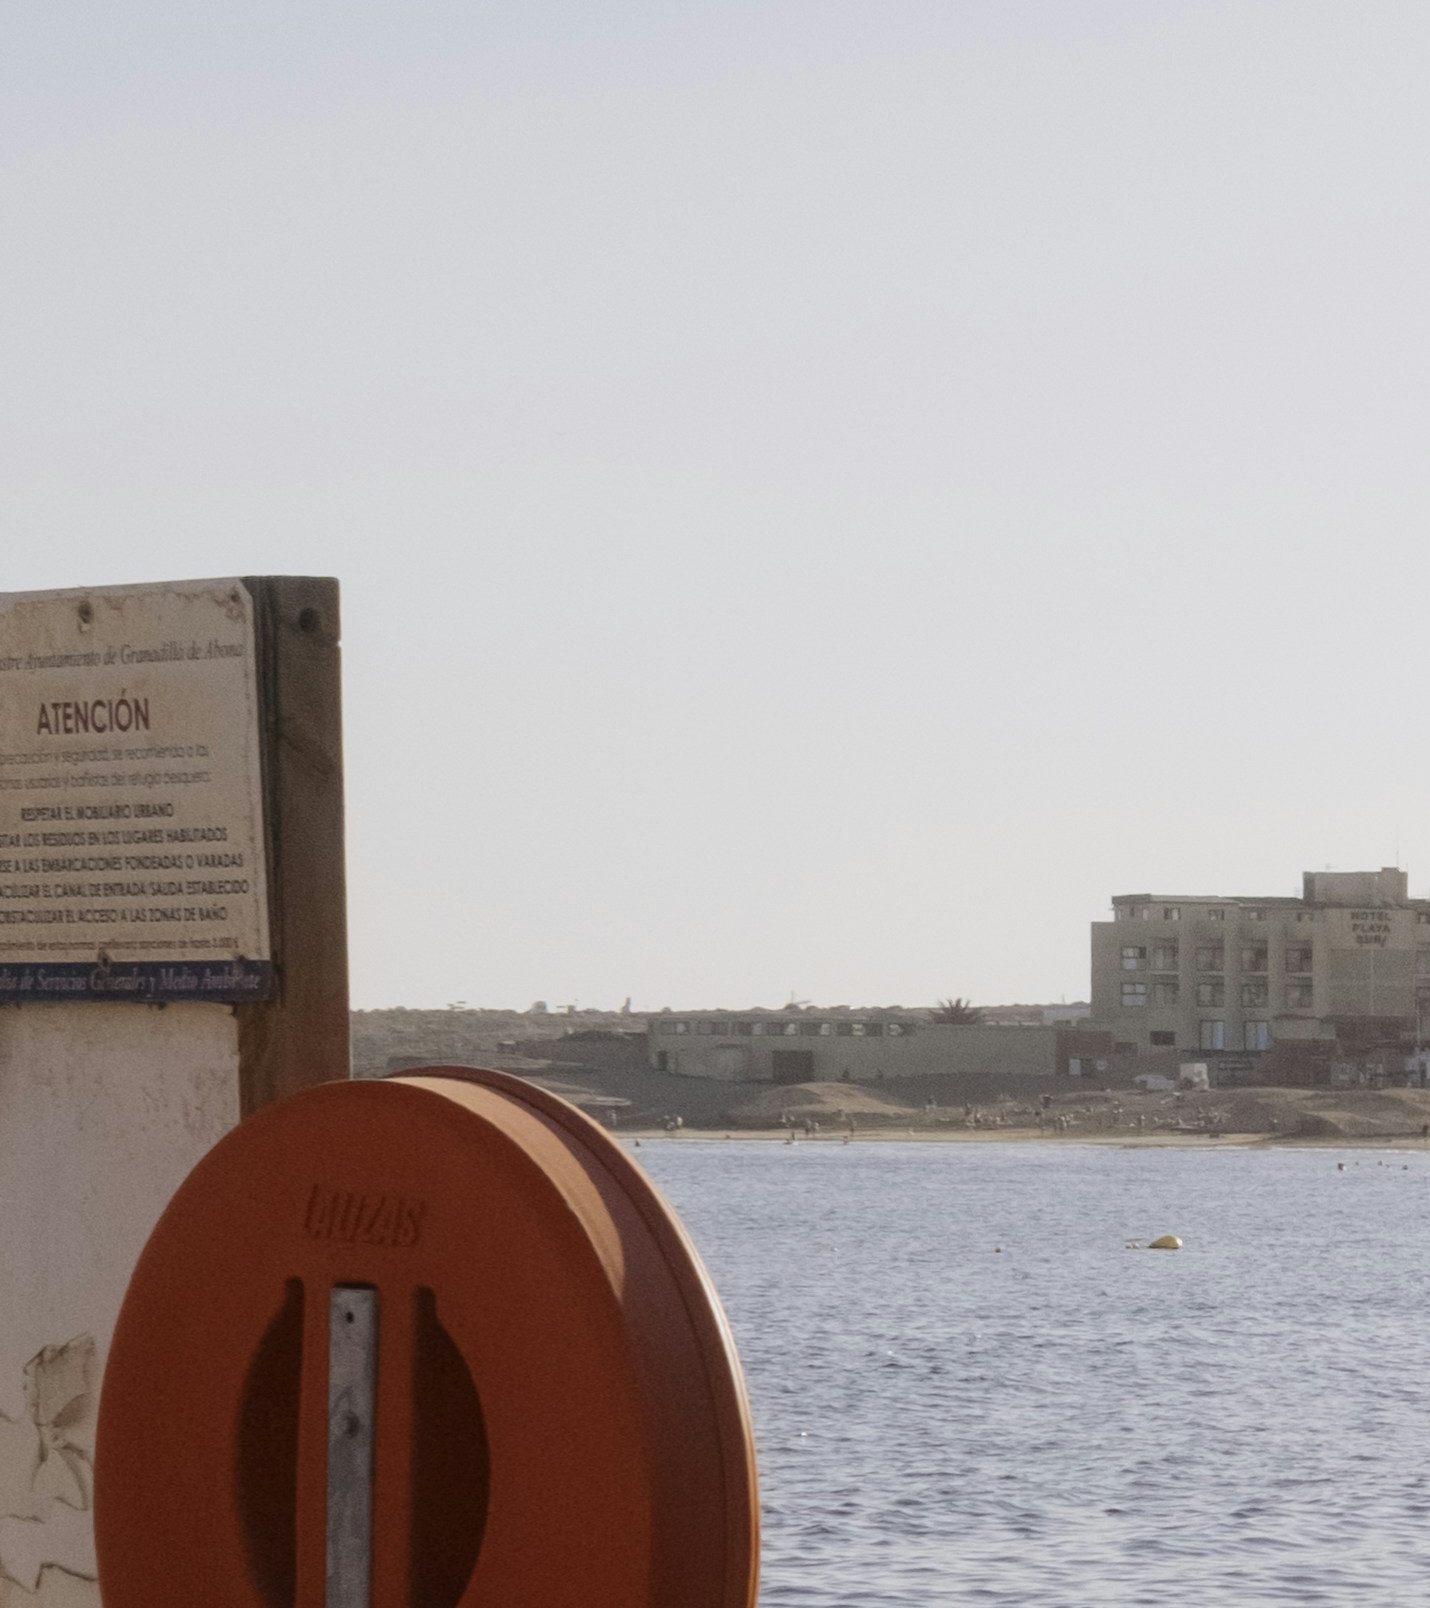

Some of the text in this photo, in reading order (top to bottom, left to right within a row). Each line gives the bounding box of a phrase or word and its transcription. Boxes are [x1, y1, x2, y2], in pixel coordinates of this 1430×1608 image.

[37, 688, 149, 735] ATENCIÓN
[21, 803, 174, 822] RESPETAR EL MOBILIARIO URBANO
[22, 832, 40, 847] LOS
[42, 832, 86, 847] RESIDUOS
[88, 831, 101, 846] EN
[103, 830, 120, 845] LOS
[122, 829, 164, 845] LUGARES
[166, 827, 228, 843] HABILITADOS
[14, 859, 20, 872] A
[22, 858, 40, 873] LAS
[41, 857, 122, 873] EMBARCACIONES
[124, 855, 183, 871] FONDEADAS
[185, 854, 194, 870] O
[196, 853, 244, 869] VARADAS
[186, 879, 250, 895] ESTABLECIDO
[79, 908, 117, 924] ACCESO
[130, 907, 147, 923] LAS
[148, 906, 181, 923] ZONAS
[183, 906, 197, 922] DE
[198, 903, 228, 922] BAÑO
